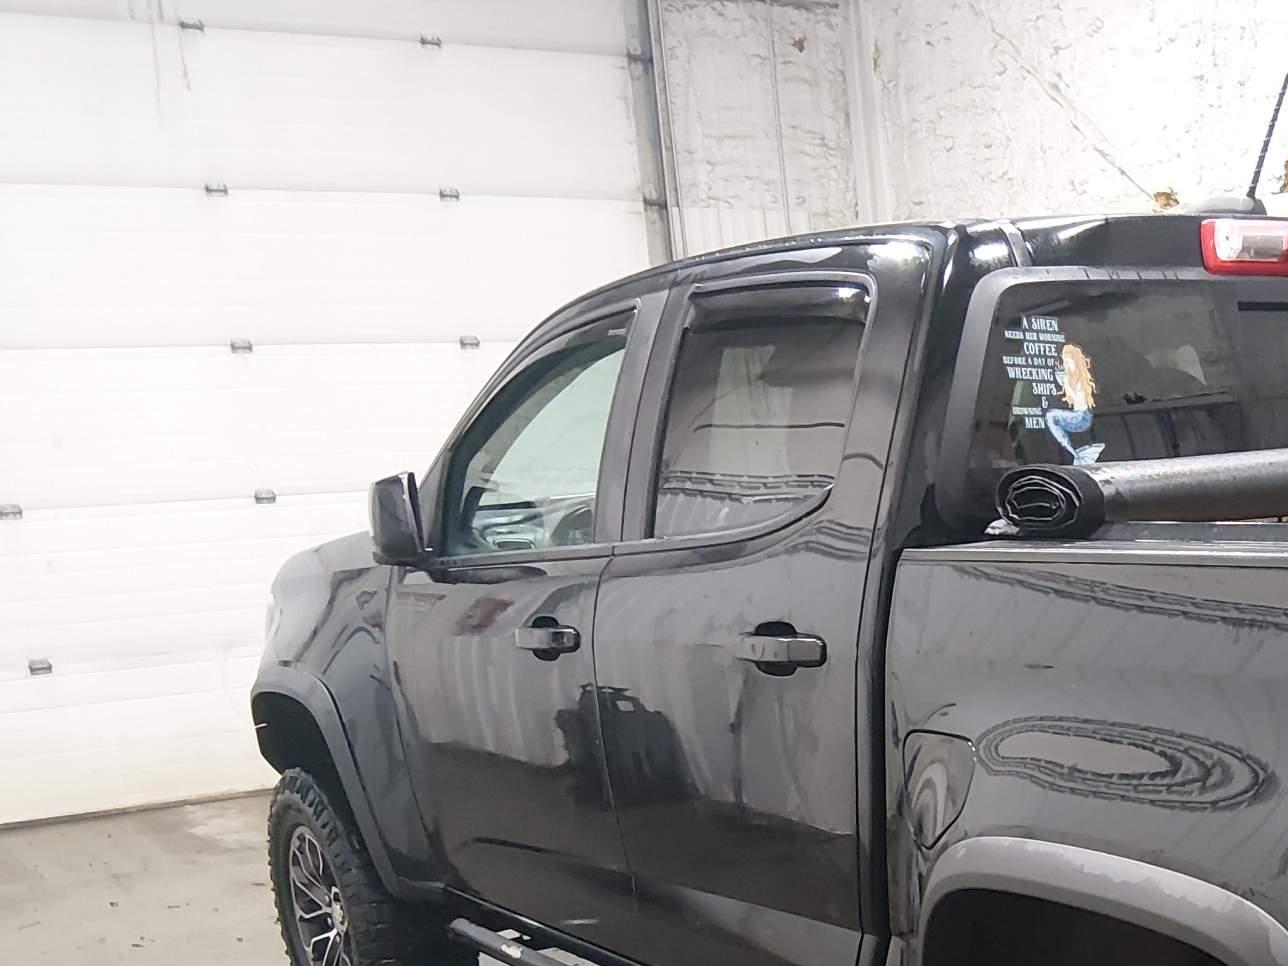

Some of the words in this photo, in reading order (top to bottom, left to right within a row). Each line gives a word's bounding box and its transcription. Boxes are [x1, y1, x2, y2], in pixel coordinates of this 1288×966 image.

[1022, 317, 1029, 329] A
[1031, 318, 1058, 331] SIREN
[1023, 342, 1058, 356] COFFEE
[1002, 355, 1026, 365] BEFORE
[1033, 356, 1046, 366] DAY
[1006, 366, 1054, 381] WRECKING
[1032, 382, 1057, 396] SHIPS
[1041, 396, 1048, 409] &
[1025, 416, 1045, 429] MEN
